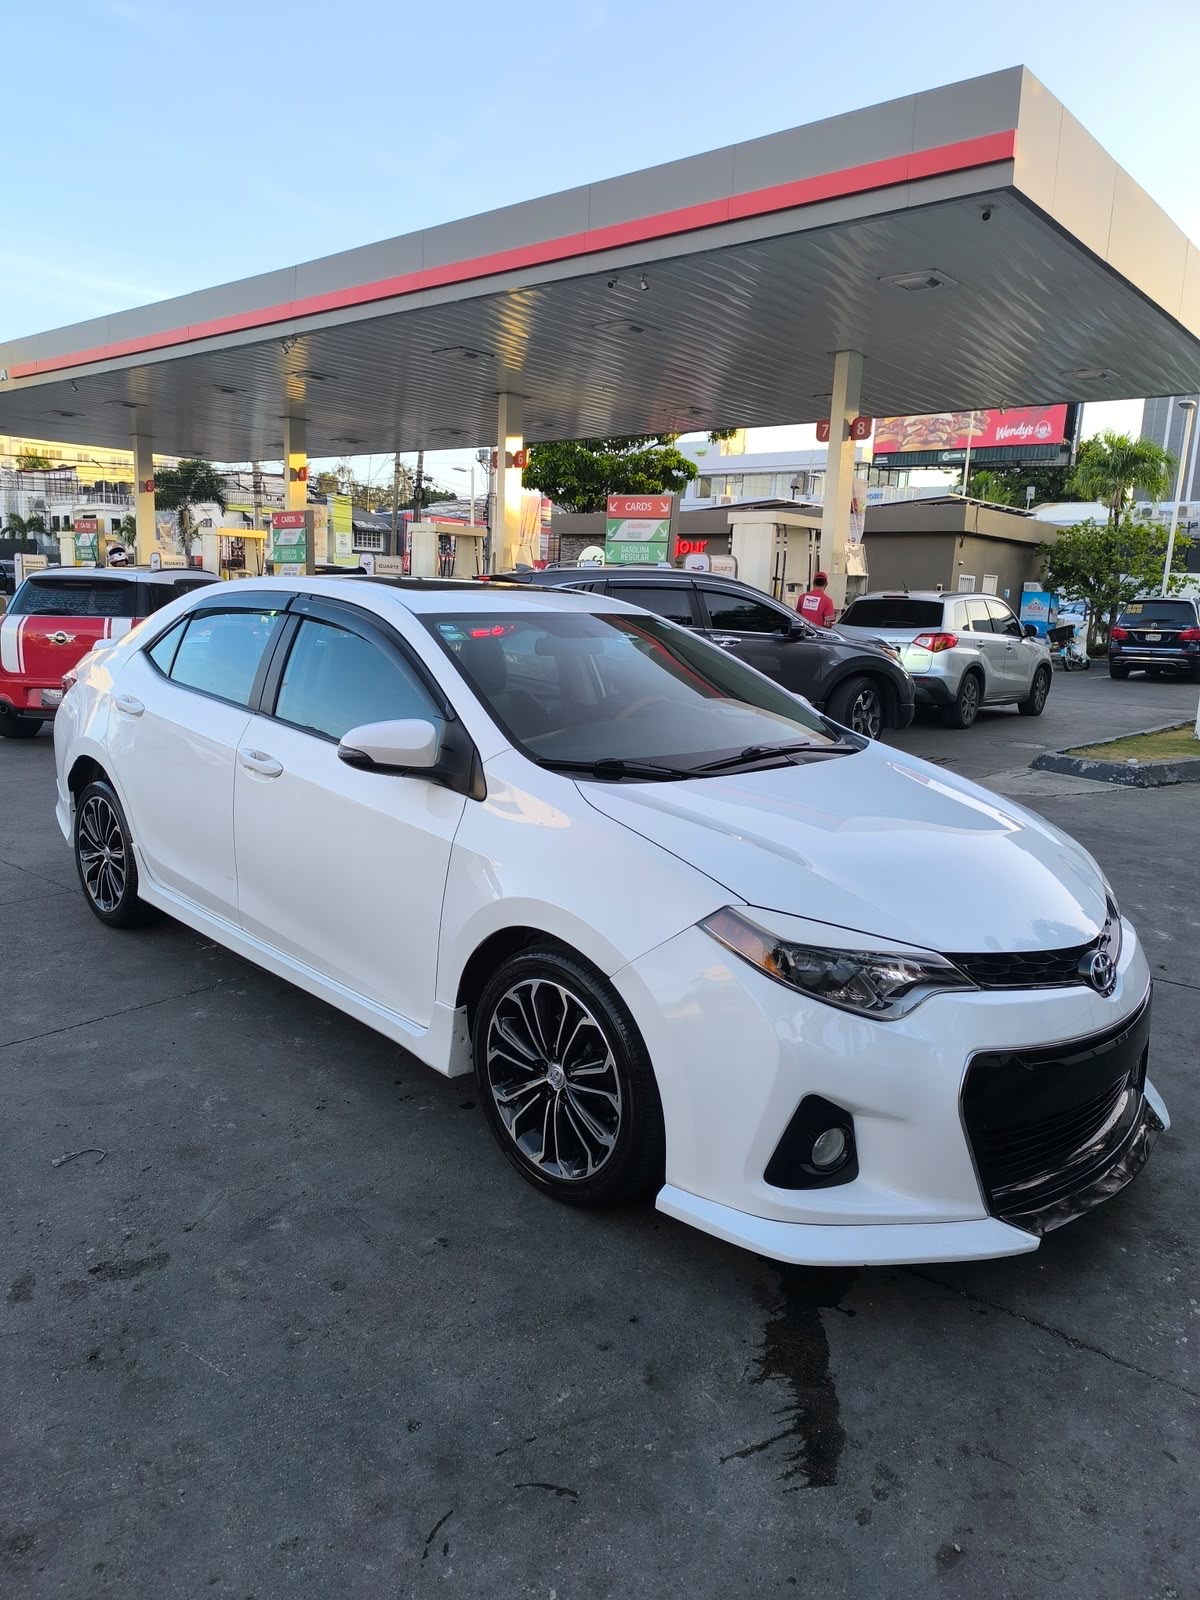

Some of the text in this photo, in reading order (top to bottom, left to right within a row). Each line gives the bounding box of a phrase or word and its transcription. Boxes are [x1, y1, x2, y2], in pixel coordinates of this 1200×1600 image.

[821, 424, 830, 437] 7
[856, 421, 866, 435] 8
[995, 422, 1034, 440] Wendy's
[517, 453, 523, 464] 6
[625, 502, 652, 512] CARDS
[280, 516, 297, 524] CARDS
[621, 545, 649, 553] GASOLINA
[620, 553, 649, 561] REGULAR
